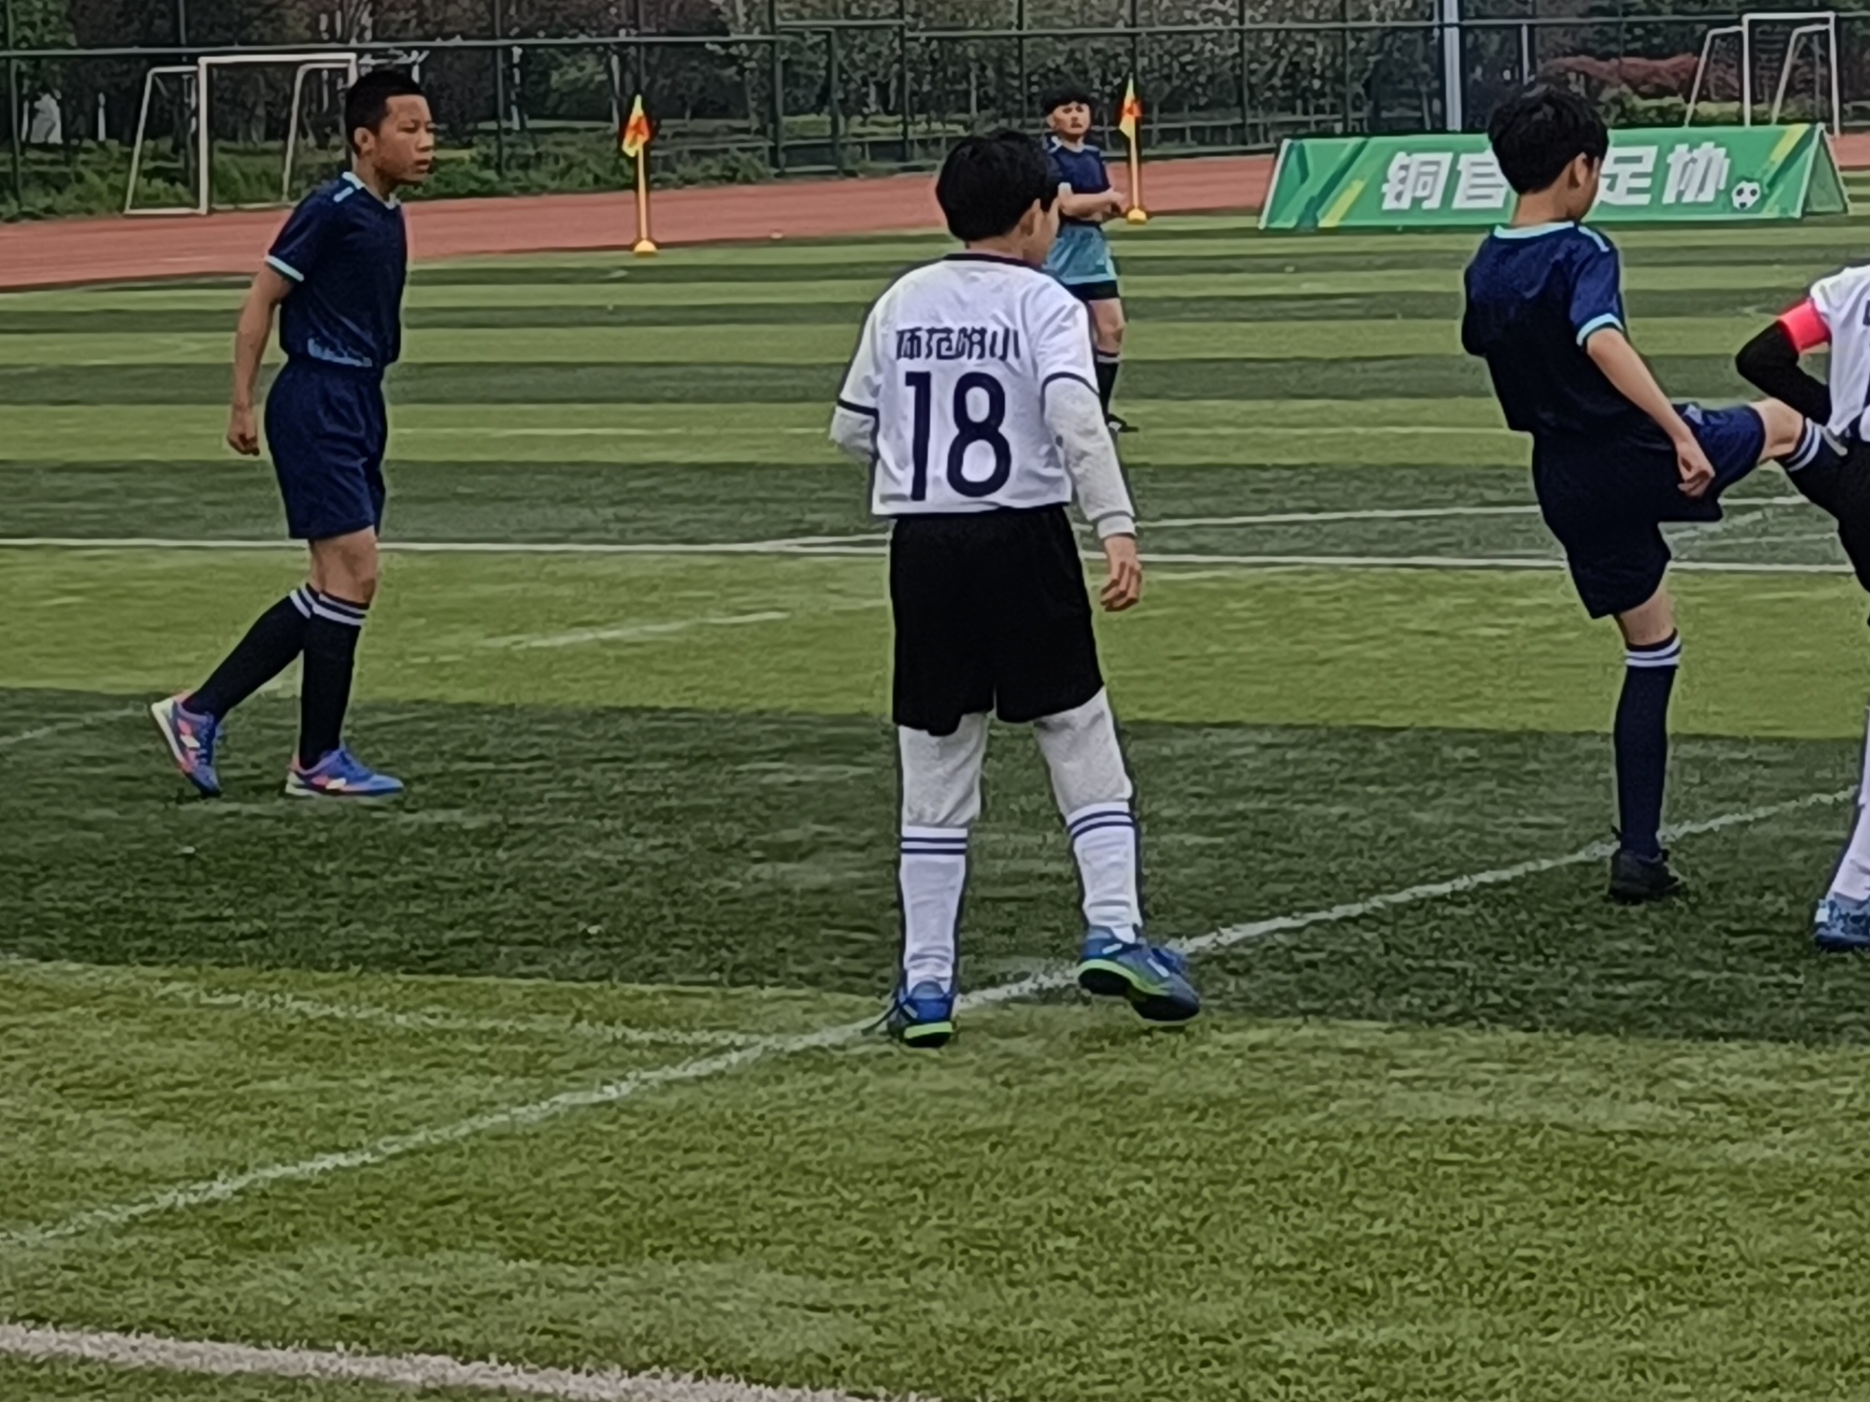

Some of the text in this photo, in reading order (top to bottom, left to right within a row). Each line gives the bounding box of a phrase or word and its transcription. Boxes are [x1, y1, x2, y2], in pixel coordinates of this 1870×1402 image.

[1381, 141, 1732, 210] 铜官足协
[905, 371, 1012, 502] 18
